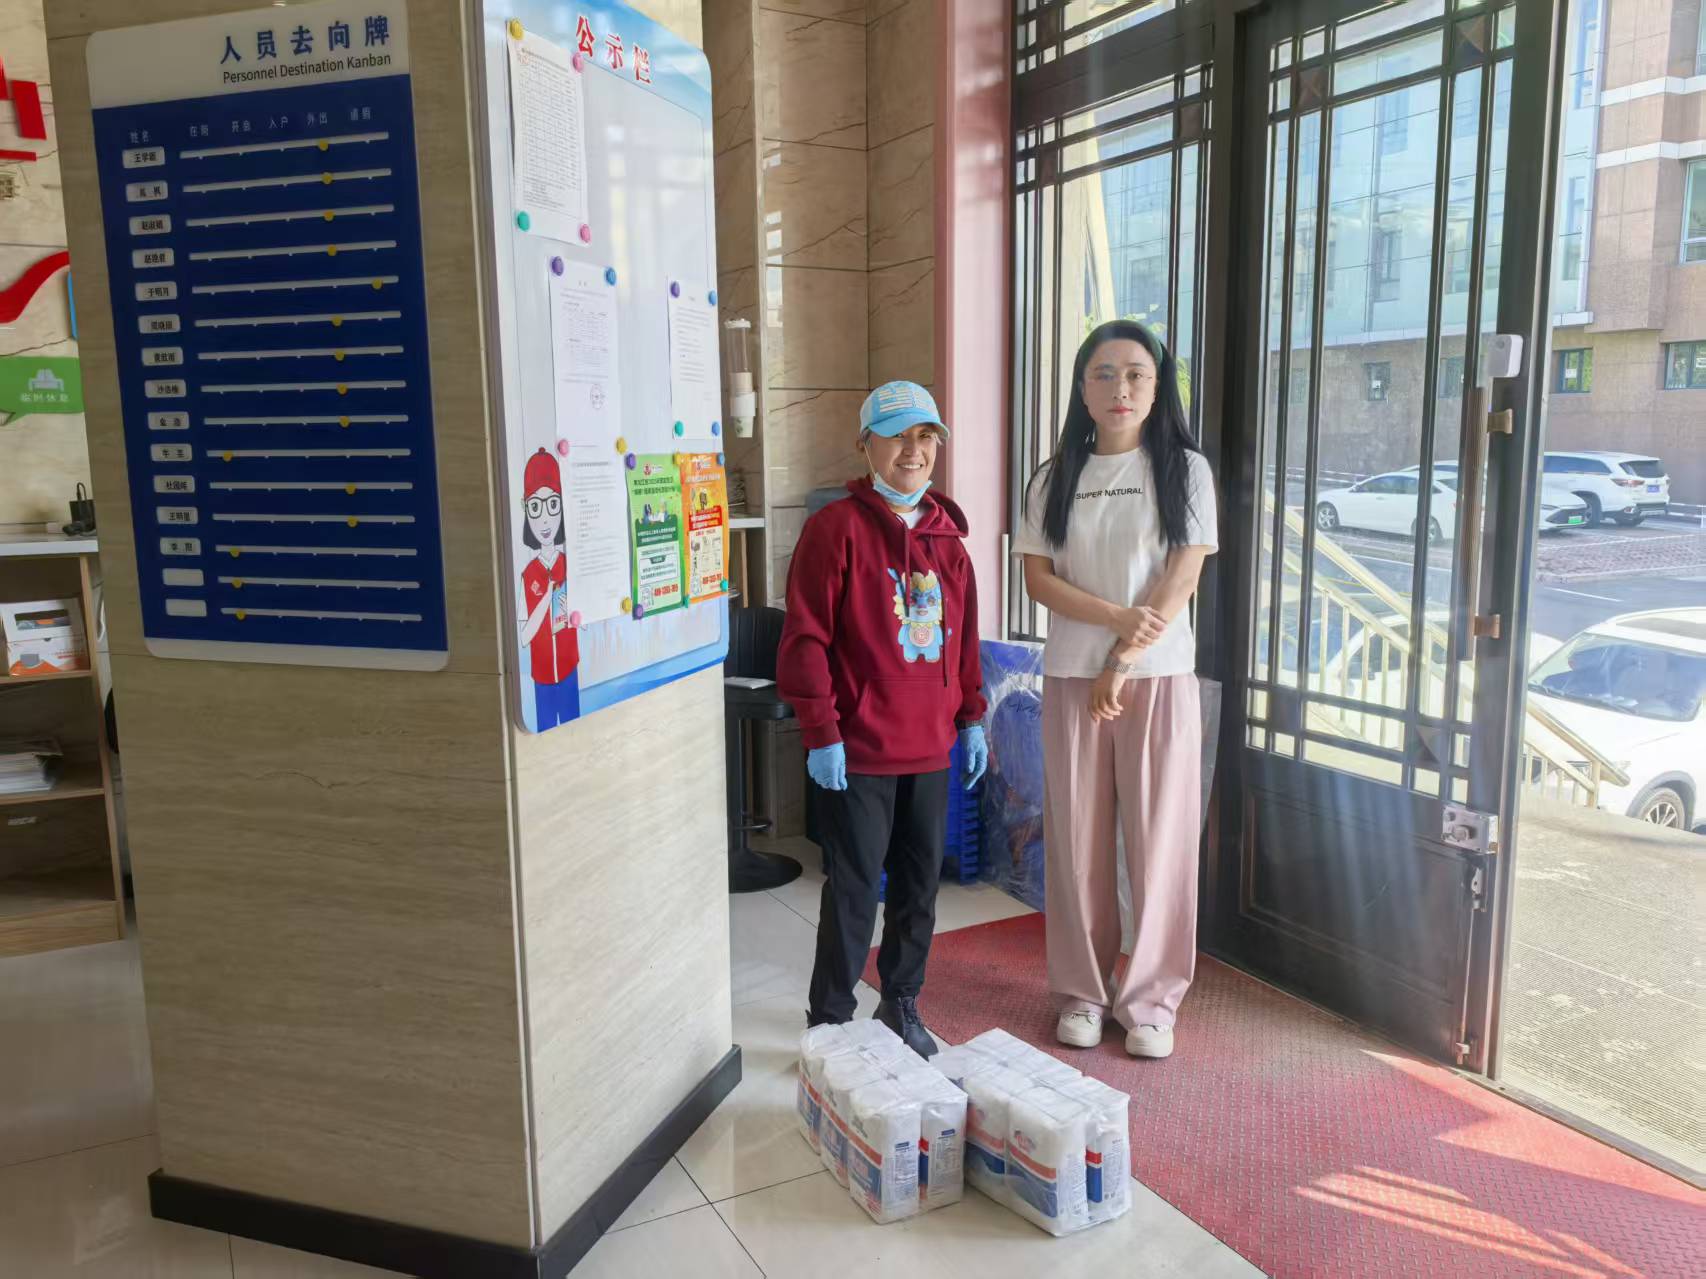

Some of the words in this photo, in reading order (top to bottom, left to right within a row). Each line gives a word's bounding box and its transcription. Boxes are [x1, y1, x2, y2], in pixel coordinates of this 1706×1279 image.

[220, 15, 390, 64] 人员去向牌
[575, 15, 652, 84] 公示栏
[223, 67, 277, 84] Personnel
[280, 59, 344, 77] Destination
[347, 53, 391, 69] Kanban
[1075, 490, 1103, 500] SUPER
[1104, 487, 1143, 497] NATURAL
